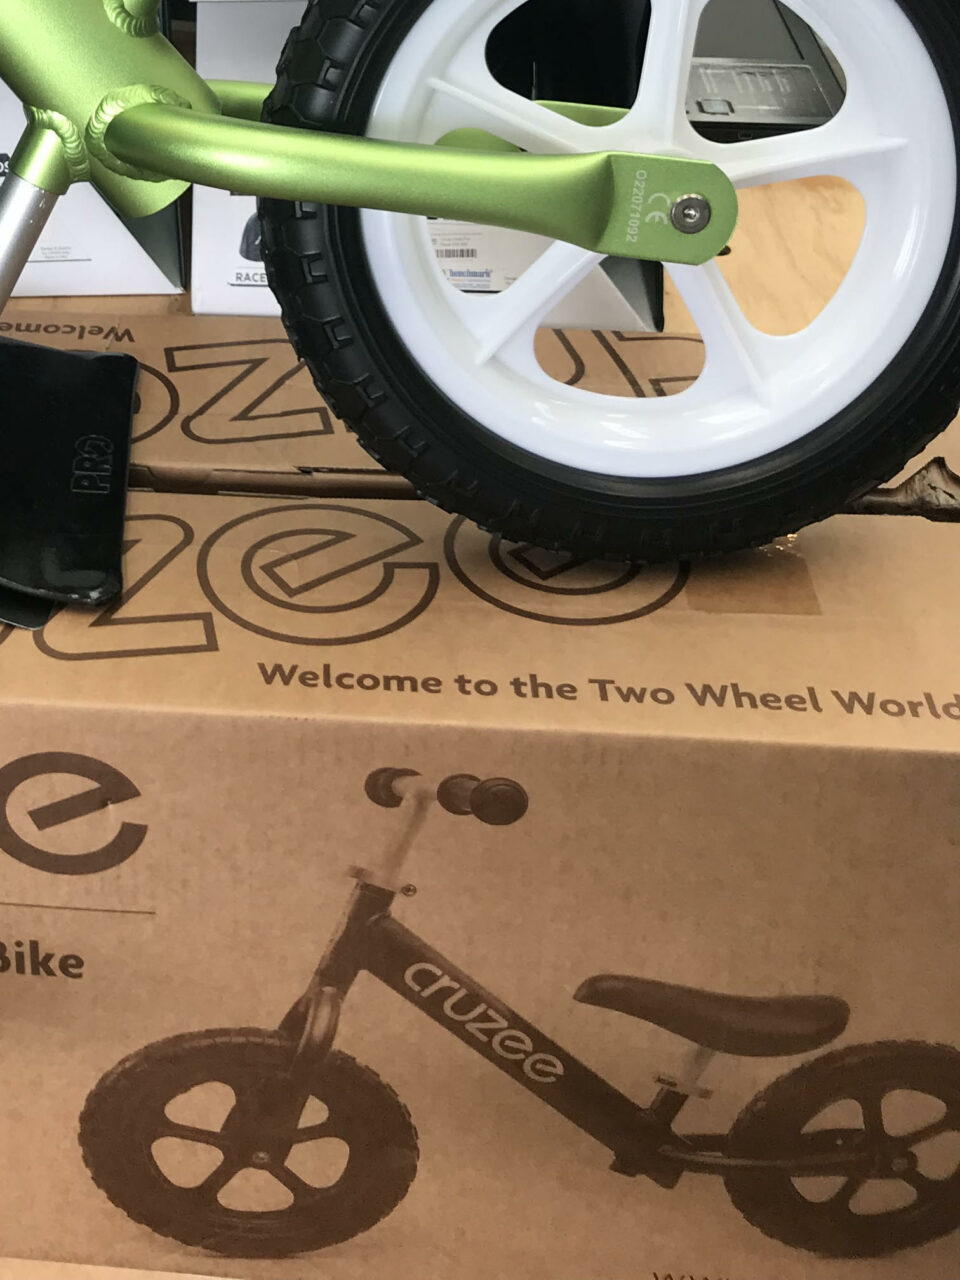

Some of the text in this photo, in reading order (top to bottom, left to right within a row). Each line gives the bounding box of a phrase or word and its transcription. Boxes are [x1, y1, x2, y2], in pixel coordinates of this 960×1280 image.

[235, 272, 268, 283] RACE
[449, 268, 491, 278] benchmark
[71, 434, 114, 494] PRO
[258, 662, 960, 720] Welcome to the Two Wheel World
[403, 962, 564, 1083] cruzee
